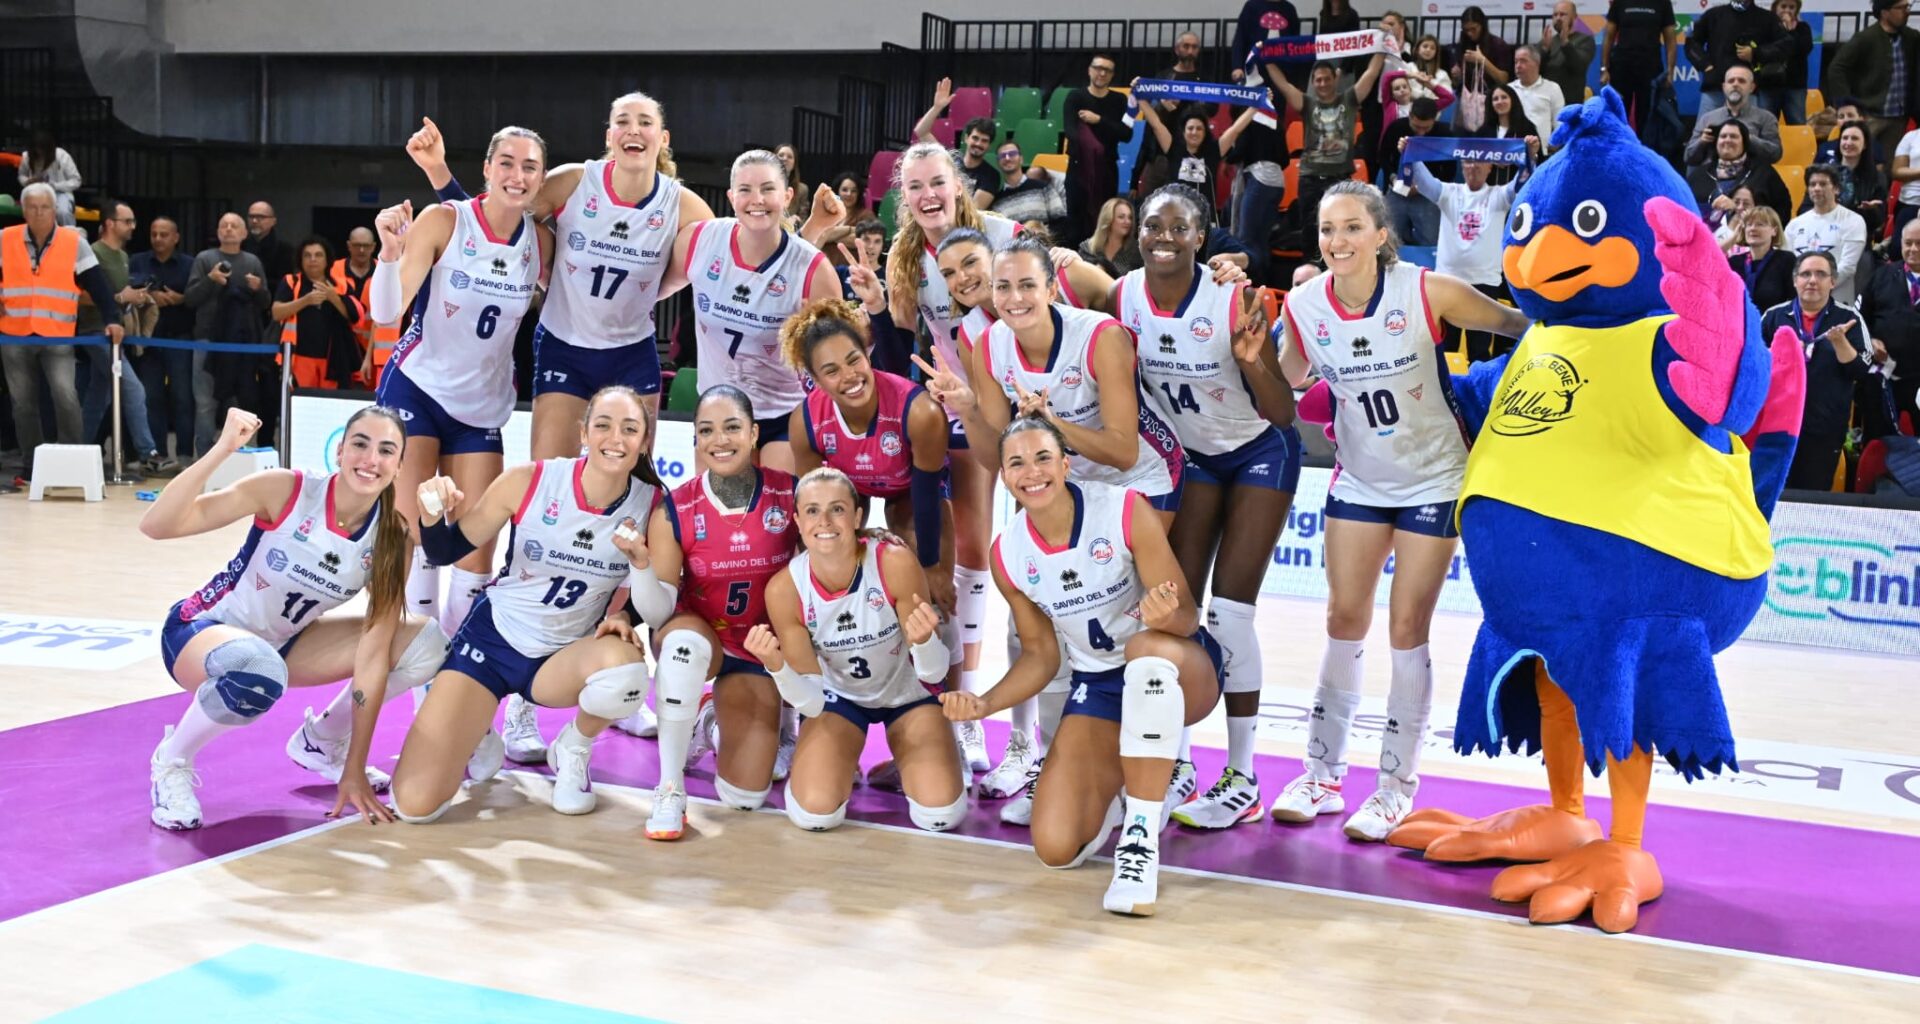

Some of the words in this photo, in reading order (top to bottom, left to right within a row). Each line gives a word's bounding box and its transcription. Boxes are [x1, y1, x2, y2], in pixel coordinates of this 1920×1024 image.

[1287, 41, 1331, 56] Scudetto
[1333, 34, 1375, 52] 2023/24
[1172, 85, 1192, 95] DEL
[1194, 86, 1220, 96] BENE
[1223, 88, 1262, 101] VOLLEY
[1452, 149, 1485, 160] PLAY
[1484, 151, 1503, 161] AS
[590, 240, 621, 254] SAVINO
[622, 246, 640, 257] DEL
[641, 250, 661, 259] BENE
[474, 277, 502, 290] SAVINO
[503, 281, 519, 292] DEL
[590, 264, 629, 300] 17
[476, 304, 502, 339] 6
[713, 302, 743, 317] SAVINO
[743, 310, 760, 322] DEL
[724, 327, 744, 360] 7
[543, 369, 568, 383] 17
[1145, 358, 1174, 370] SAVINO
[1176, 361, 1193, 372] DEL
[1195, 361, 1220, 372] BENE
[1339, 364, 1372, 376] SAVINO
[1373, 361, 1392, 372] DEL
[1394, 352, 1419, 368] BENE
[1548, 360, 1574, 387] BENE
[1075, 400, 1099, 416] BENE
[1160, 382, 1200, 414] 14
[1357, 389, 1400, 428] 10
[1503, 389, 1553, 420] Volley
[548, 549, 585, 565] SAVINO
[586, 557, 606, 571] DEL
[608, 561, 631, 571] BENE
[711, 559, 747, 570] SAVINO
[750, 557, 768, 567] DEL
[292, 563, 325, 585] SAVINO
[325, 579, 343, 596] DEL
[540, 575, 588, 609] 13
[725, 580, 752, 616] 5
[1052, 596, 1085, 610] SAVINO
[1086, 591, 1105, 602] DEL
[1106, 576, 1130, 595] BENE
[281, 591, 320, 624] 11
[824, 637, 856, 648] SAVINO
[858, 634, 876, 644] DEL
[878, 622, 900, 638] BENE
[1087, 617, 1116, 652] 4
[848, 656, 872, 680] 3
[1071, 682, 1088, 704] 4
